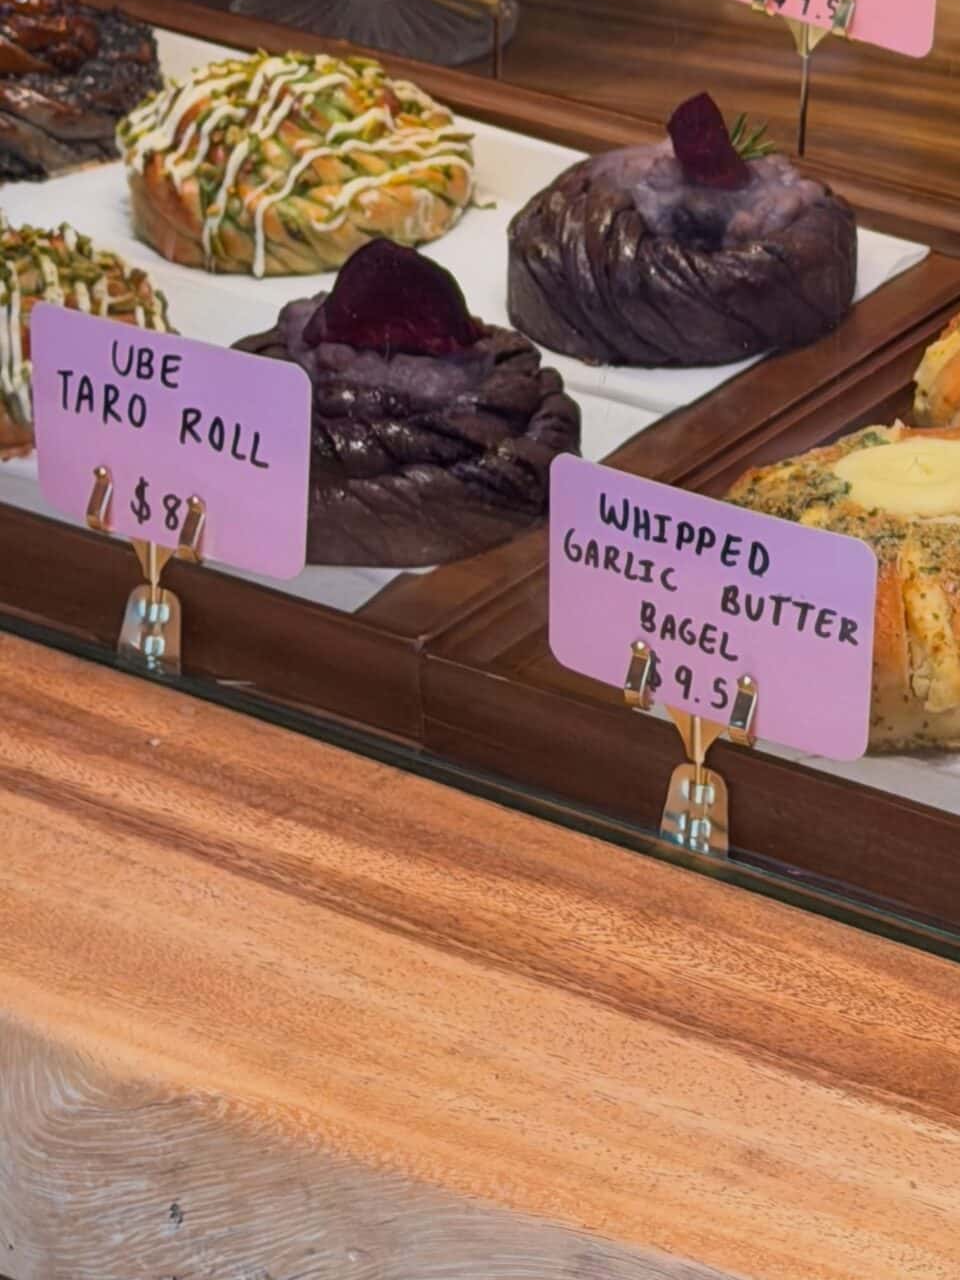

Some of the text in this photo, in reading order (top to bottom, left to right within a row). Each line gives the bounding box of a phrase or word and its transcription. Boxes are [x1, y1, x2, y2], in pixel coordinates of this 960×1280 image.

[112, 340, 182, 389] UBE
[58, 370, 269, 469] TARO ROLL
[130, 476, 182, 531] $8
[599, 493, 770, 578] WHIPPED
[563, 528, 859, 647] GARLIC BUTTER
[640, 600, 739, 662] BAGEL
